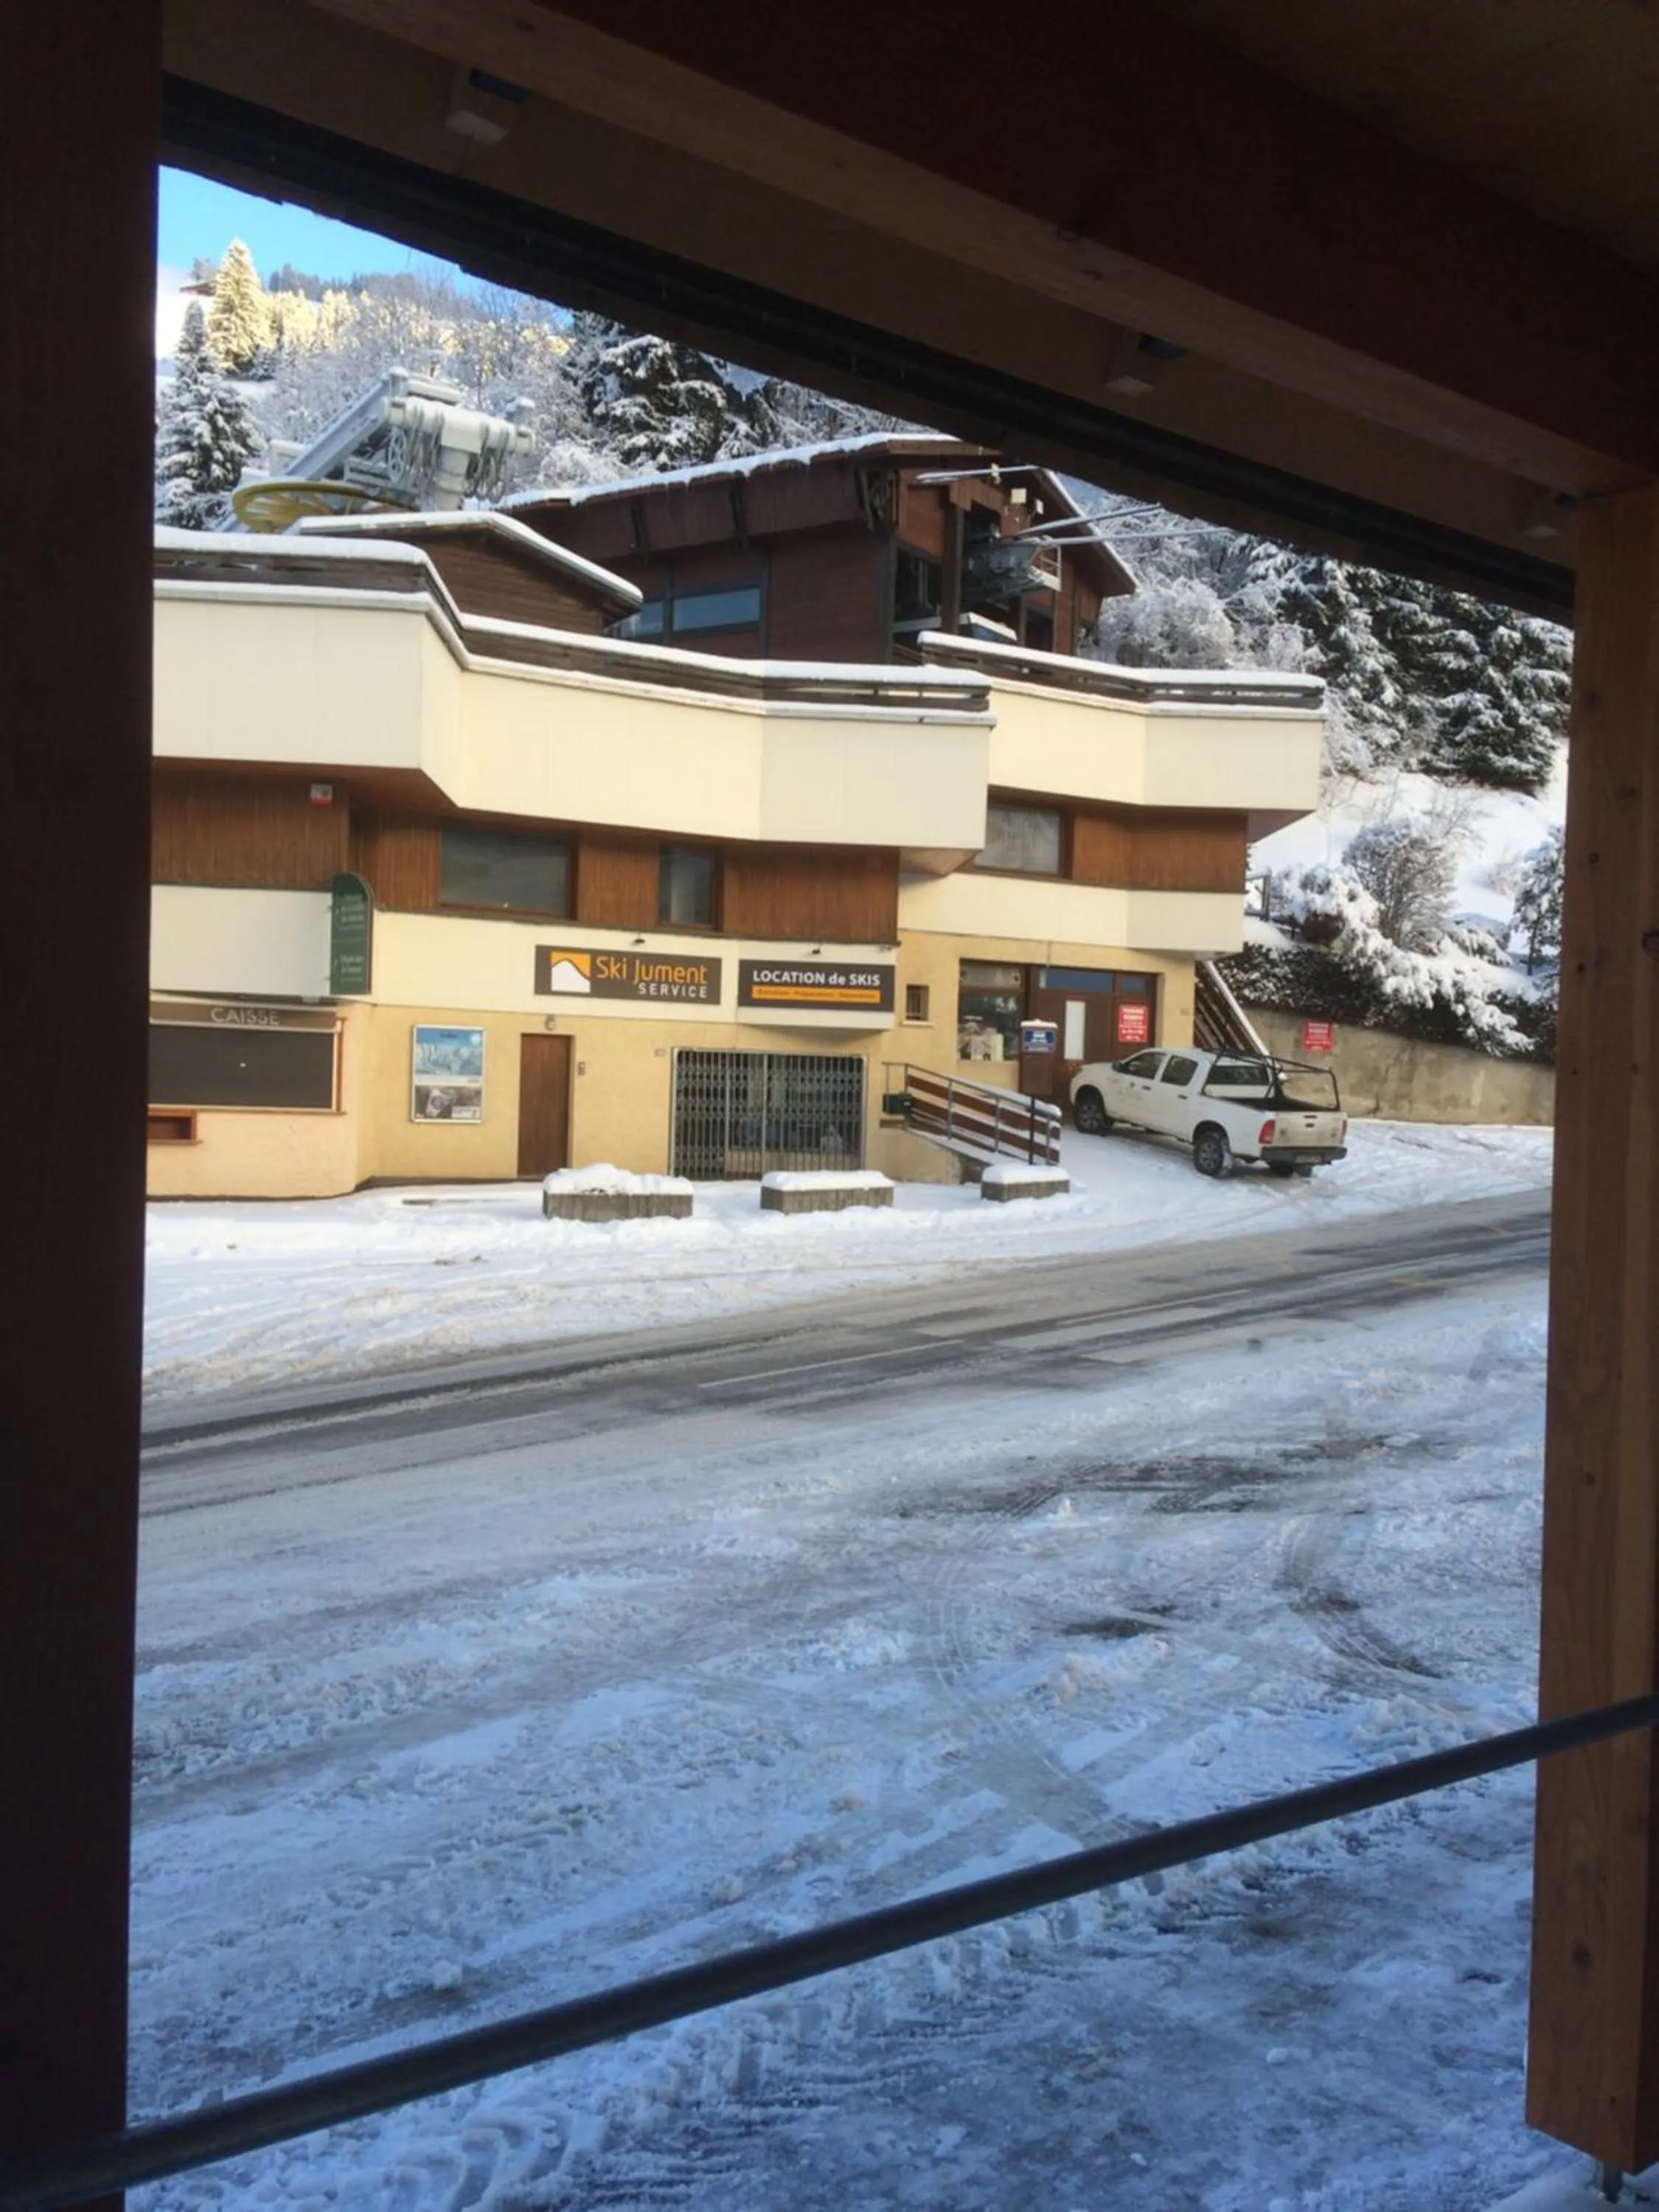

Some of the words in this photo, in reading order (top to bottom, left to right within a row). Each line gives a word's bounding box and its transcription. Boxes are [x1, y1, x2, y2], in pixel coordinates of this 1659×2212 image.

[595, 956, 627, 980] Ski
[633, 959, 708, 985] Jument
[752, 970, 826, 984] LOCATION
[828, 973, 846, 986] de
[849, 973, 881, 987] SKIS
[638, 982, 708, 998] SERVICE
[211, 1007, 280, 1026] CAISSE
